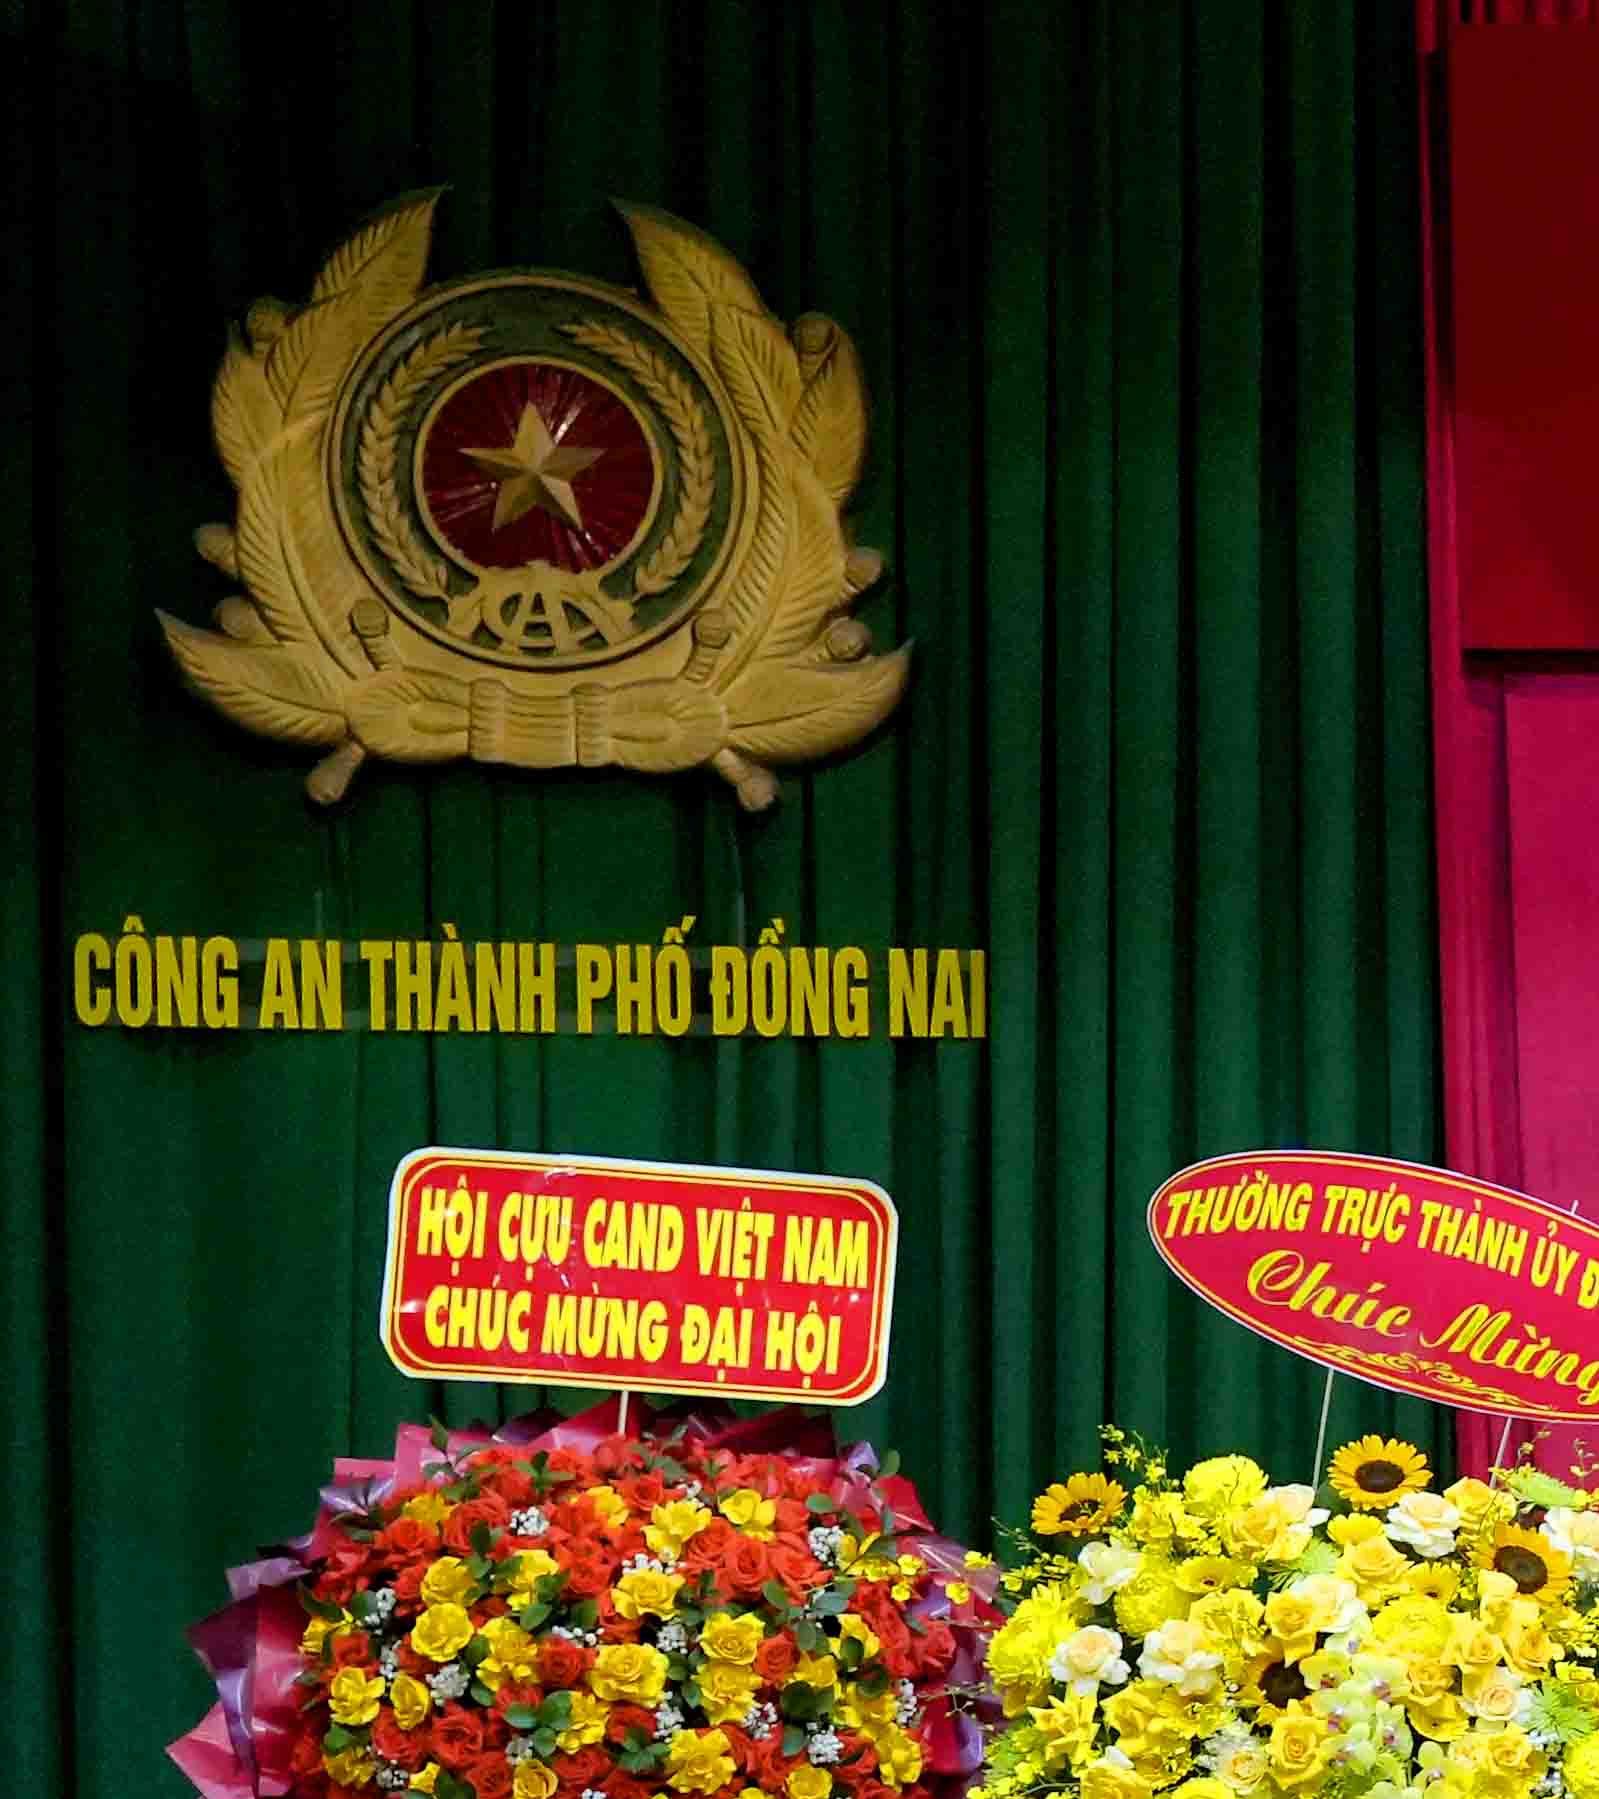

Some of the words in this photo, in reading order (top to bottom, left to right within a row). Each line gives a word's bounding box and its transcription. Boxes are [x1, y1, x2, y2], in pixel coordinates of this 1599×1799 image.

[74, 915, 239, 1029] CÔNG
[258, 938, 343, 1030] AN
[359, 923, 556, 1033] THÀNH
[575, 915, 697, 1037] PHỐ
[709, 918, 869, 1038] ĐỒNG
[888, 948, 986, 1038] NAI
[417, 1175, 488, 1275] HỘI
[498, 1193, 574, 1280] CỰU
[583, 1199, 684, 1272] CAND
[696, 1197, 774, 1296] VIỆT
[782, 1216, 869, 1288] NAM
[1320, 1182, 1411, 1253] TRỰC
[1416, 1200, 1530, 1276] THÀNH
[1529, 1221, 1580, 1296] ỦY
[424, 1275, 530, 1352] CHÚC
[540, 1282, 668, 1363] MỪNG
[680, 1304, 751, 1382] ĐẠI
[765, 1303, 841, 1389] HỘI
[1246, 1249, 1414, 1339] Chúc
